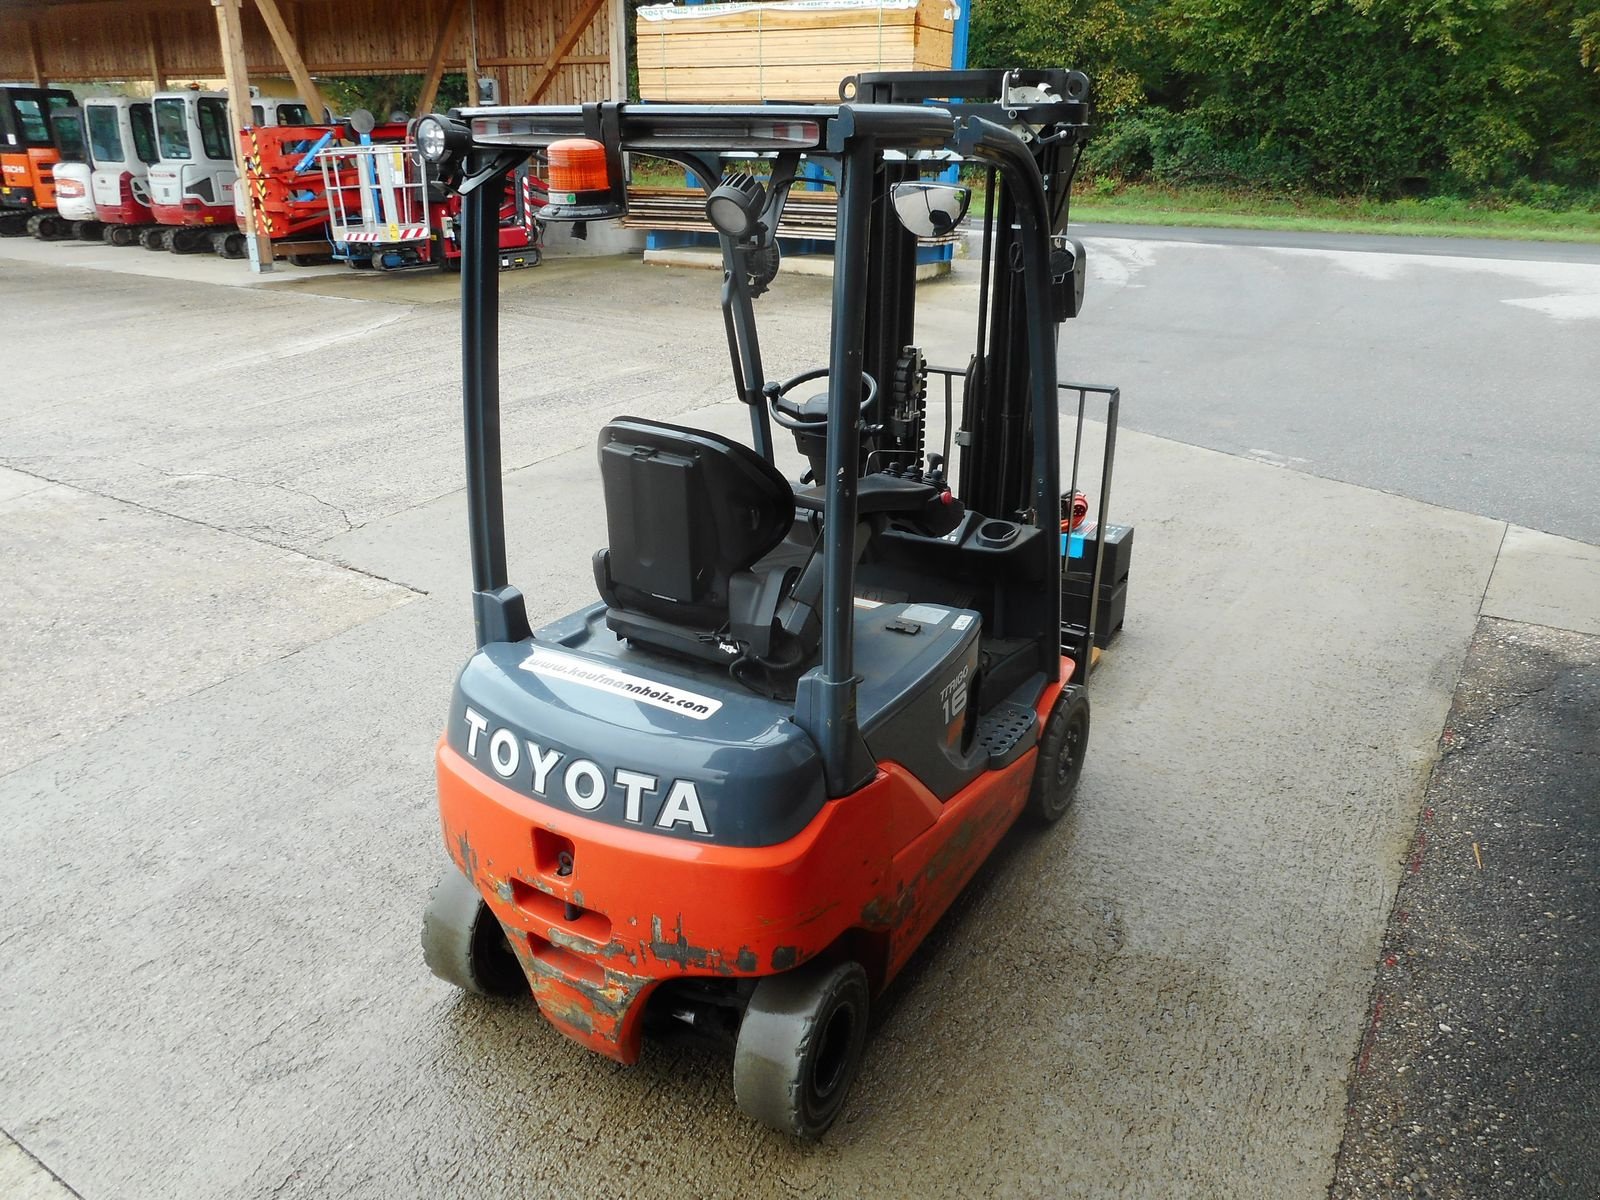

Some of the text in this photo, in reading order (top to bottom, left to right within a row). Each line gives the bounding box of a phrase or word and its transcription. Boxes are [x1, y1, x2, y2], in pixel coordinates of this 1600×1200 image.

[528, 657, 709, 714] www.kaufmannholz.com
[942, 681, 968, 725] 16
[464, 706, 710, 834] TOYOTA
